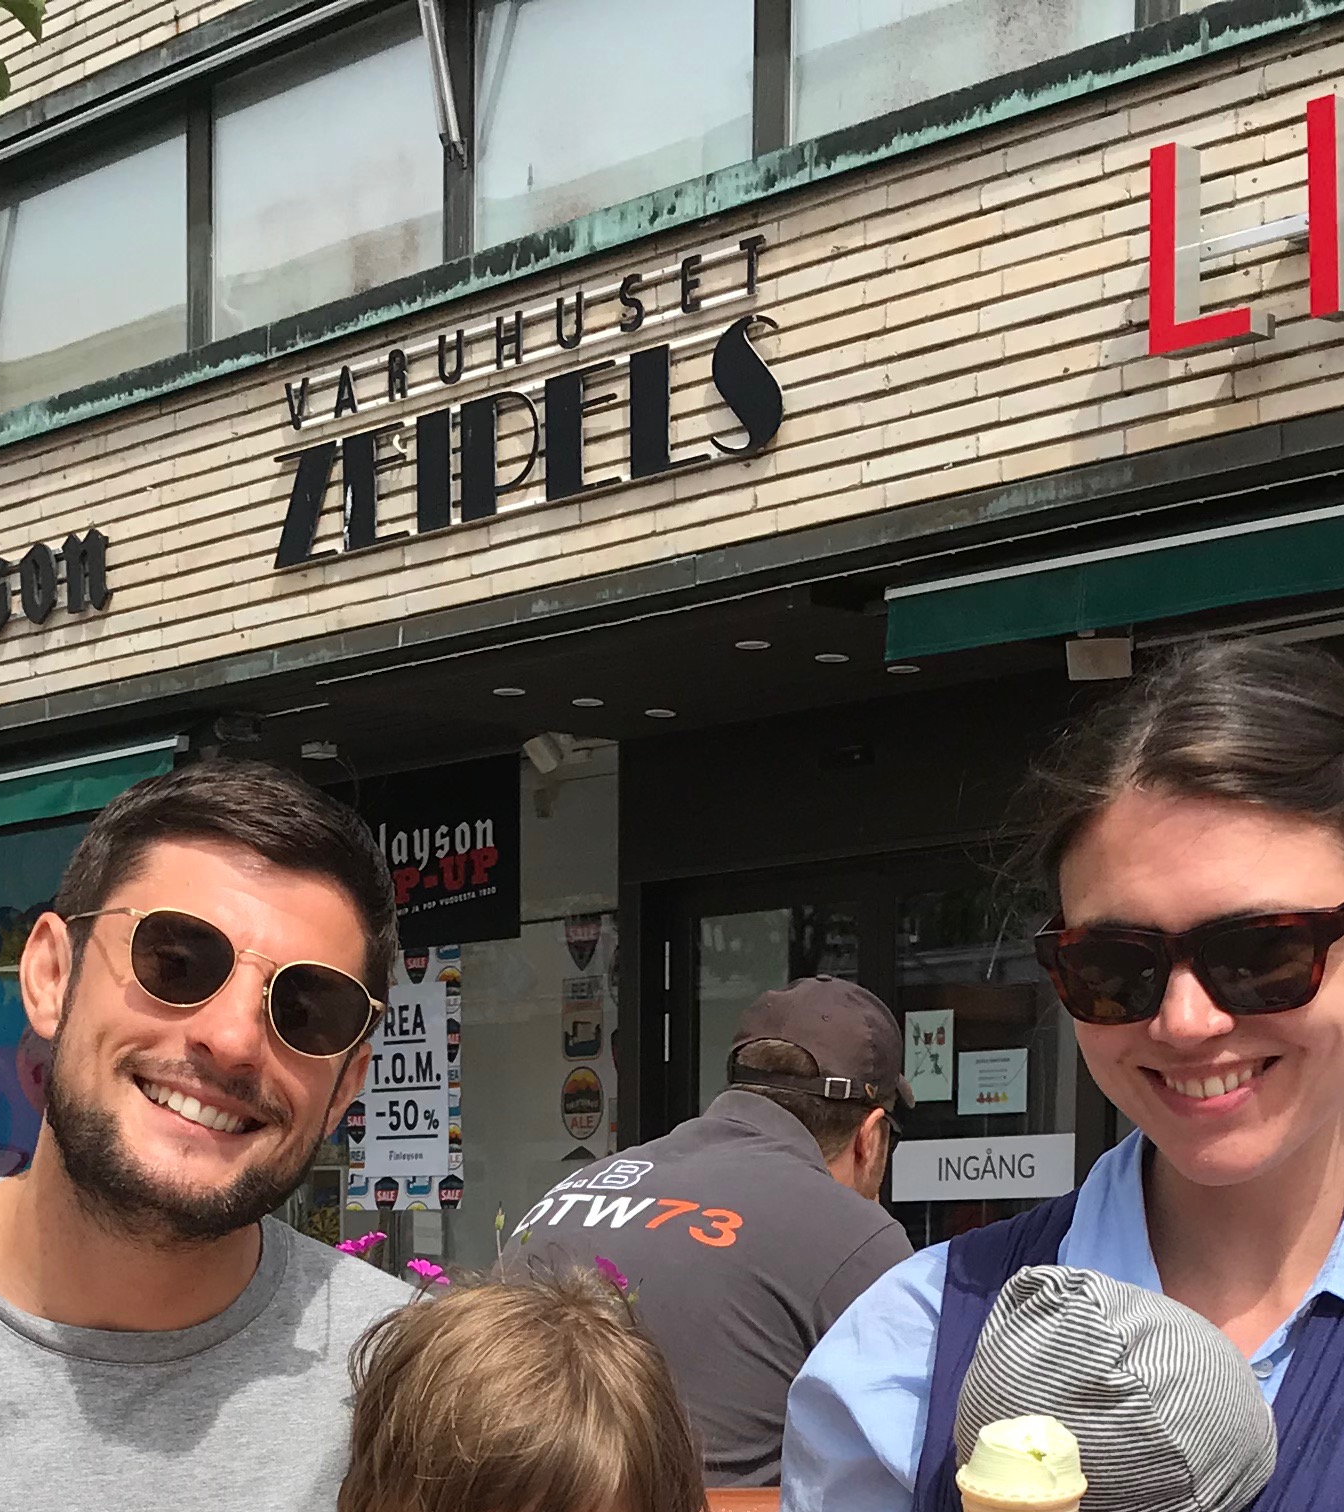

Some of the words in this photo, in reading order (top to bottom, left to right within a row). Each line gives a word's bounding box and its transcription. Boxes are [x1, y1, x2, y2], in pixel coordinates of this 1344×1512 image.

[284, 234, 766, 431] VARUHUSET
[273, 315, 784, 569] ZEIPELS
[378, 818, 495, 871] layson
[393, 846, 498, 904] P-UP
[384, 1004, 426, 1037] REA
[372, 1051, 441, 1085] T.O.M.
[938, 1148, 1035, 1182] INGÅNG
